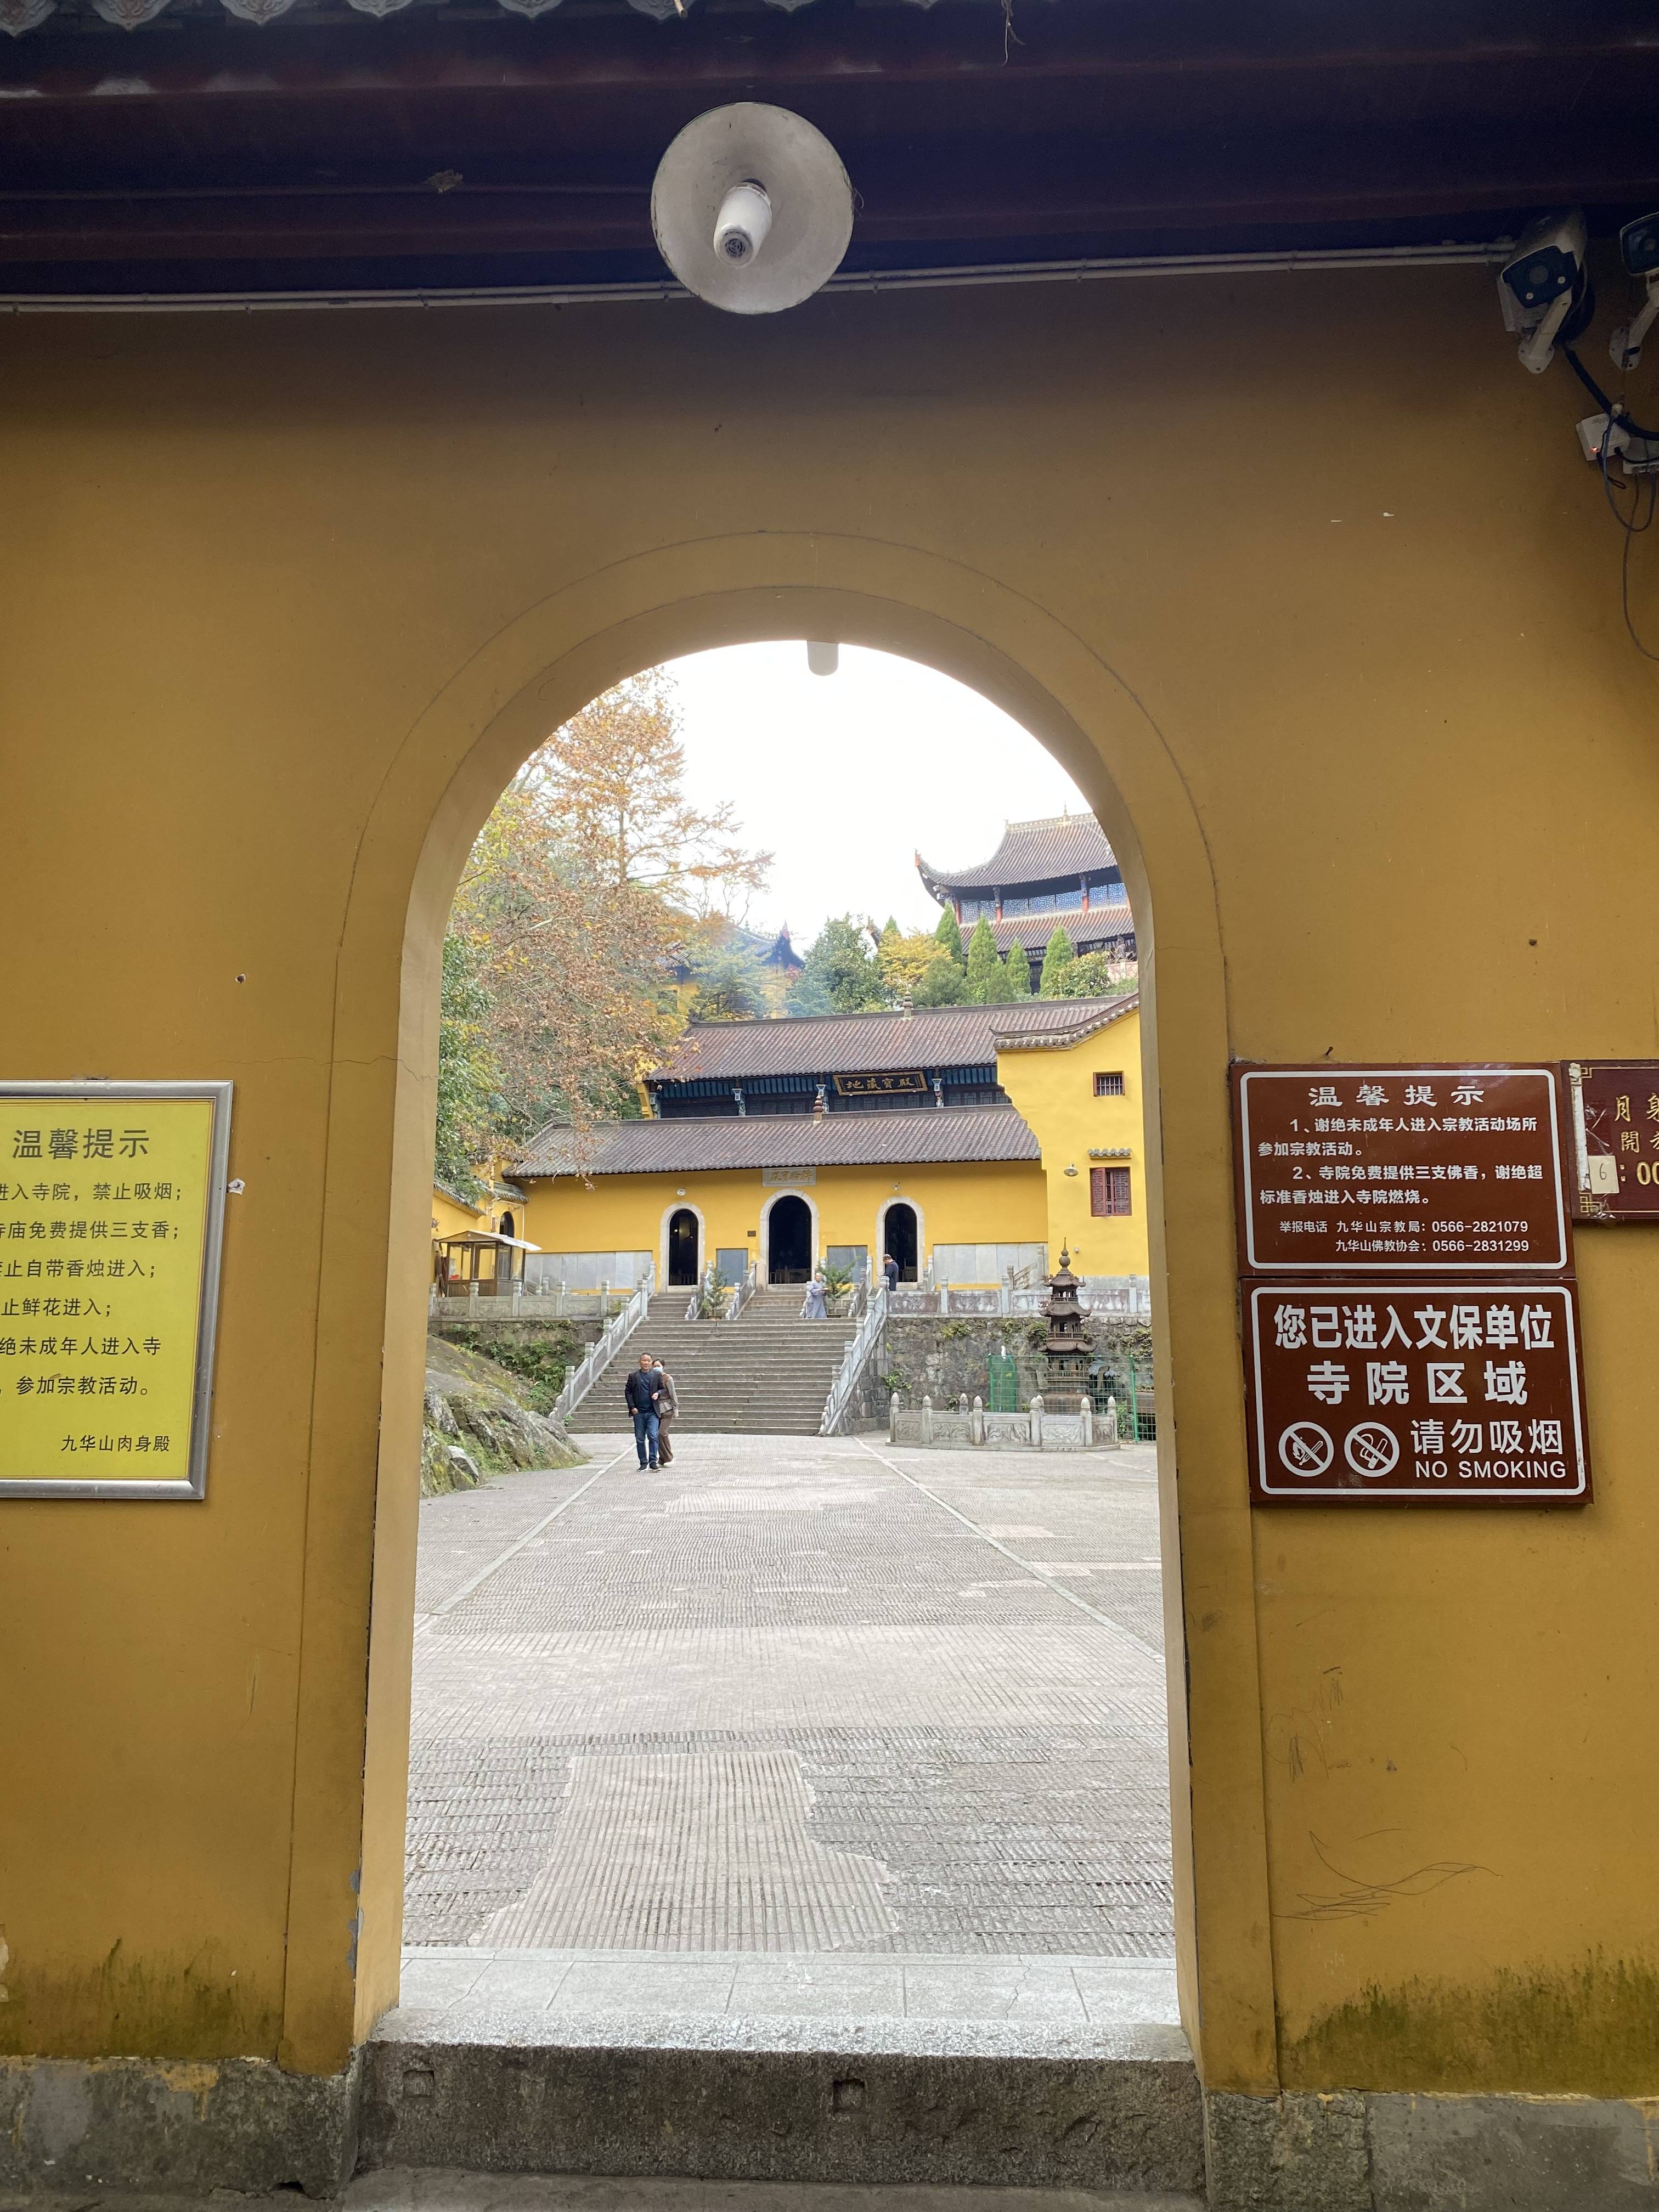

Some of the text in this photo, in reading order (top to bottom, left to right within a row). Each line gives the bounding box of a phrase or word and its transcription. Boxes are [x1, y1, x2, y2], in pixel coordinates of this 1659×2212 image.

[846, 1078, 915, 1090] 地藏寶殿
[1309, 1082, 1484, 1107] 温馨提示
[1290, 1117, 1537, 1132] 1、谢绝未成年人进入宗教活动场所
[13, 1128, 149, 1159] 温馨提示
[1259, 1142, 1361, 1156] 参加宗教活动。
[1293, 1165, 1543, 1180] 2、寺院免费提供三支佛香，谢绝超
[1599, 1163, 1607, 1180] 6
[1260, 1189, 1428, 1204] 标准香烛进入寺院燃烧。
[1280, 1221, 1327, 1232] 举报电话
[0, 1260, 155, 1277] 止自带香烛进入；
[1, 1298, 111, 1316] 止鲜花进入；
[1274, 1305, 1554, 1350] 您已进入文保单位
[0, 1337, 161, 1355] 绝未成年人进入寺
[1307, 1361, 1527, 1405] 寺院区域
[61, 1435, 170, 1452] 九华山肉身殿
[1410, 1419, 1562, 1454] 请勿吸烟
[1416, 1461, 1565, 1477] NO SMOKING
